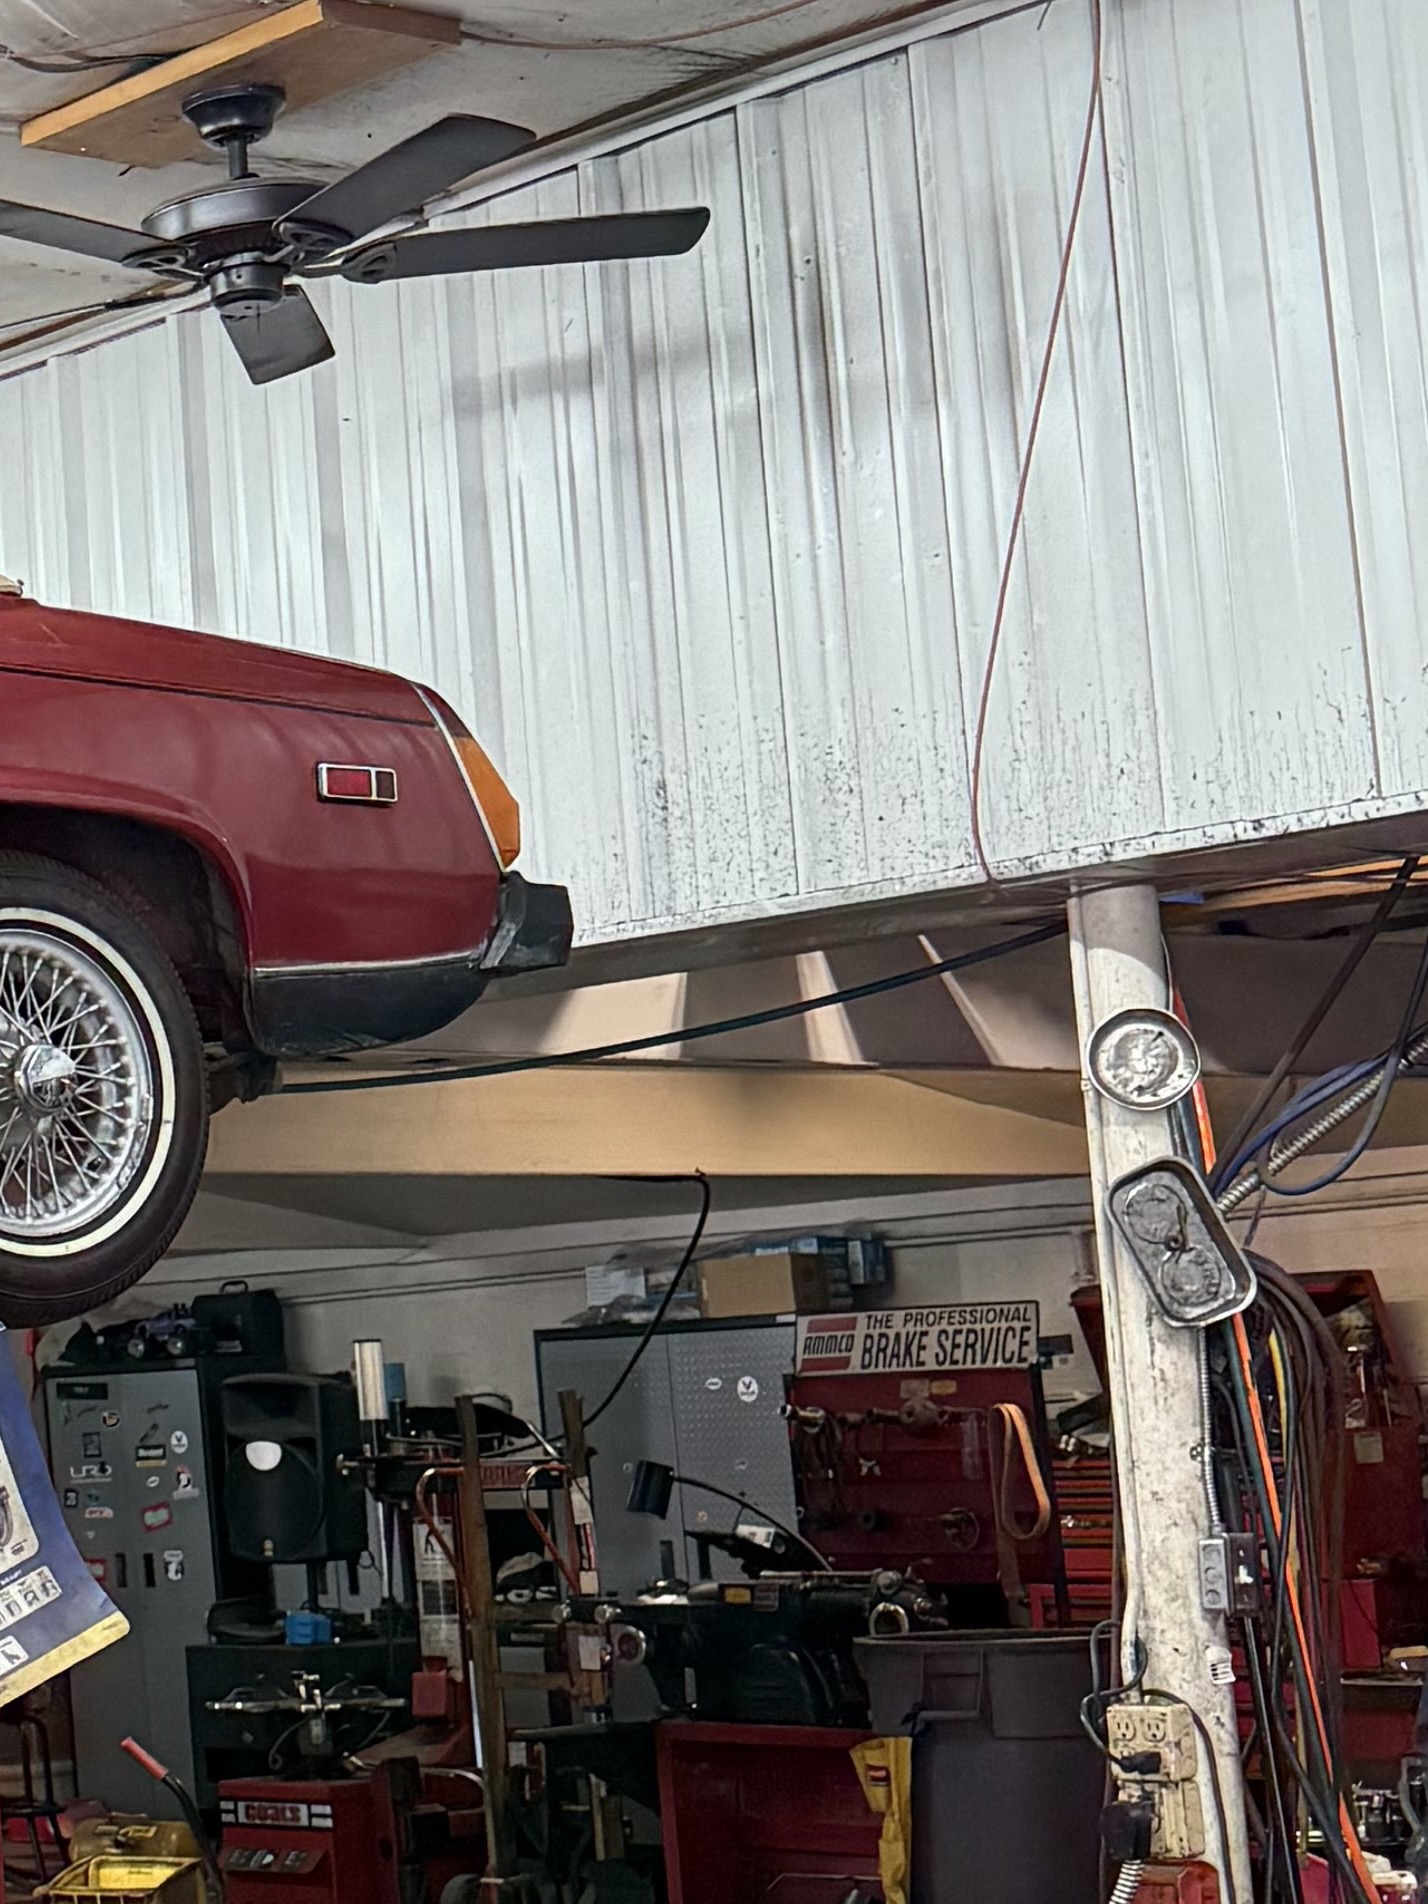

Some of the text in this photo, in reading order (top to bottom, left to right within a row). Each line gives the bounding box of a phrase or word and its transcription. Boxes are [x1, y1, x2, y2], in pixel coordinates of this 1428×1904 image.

[866, 1306, 1032, 1330] THE PROFESSIONAL
[860, 1325, 1032, 1370] BRAKE SERVICE
